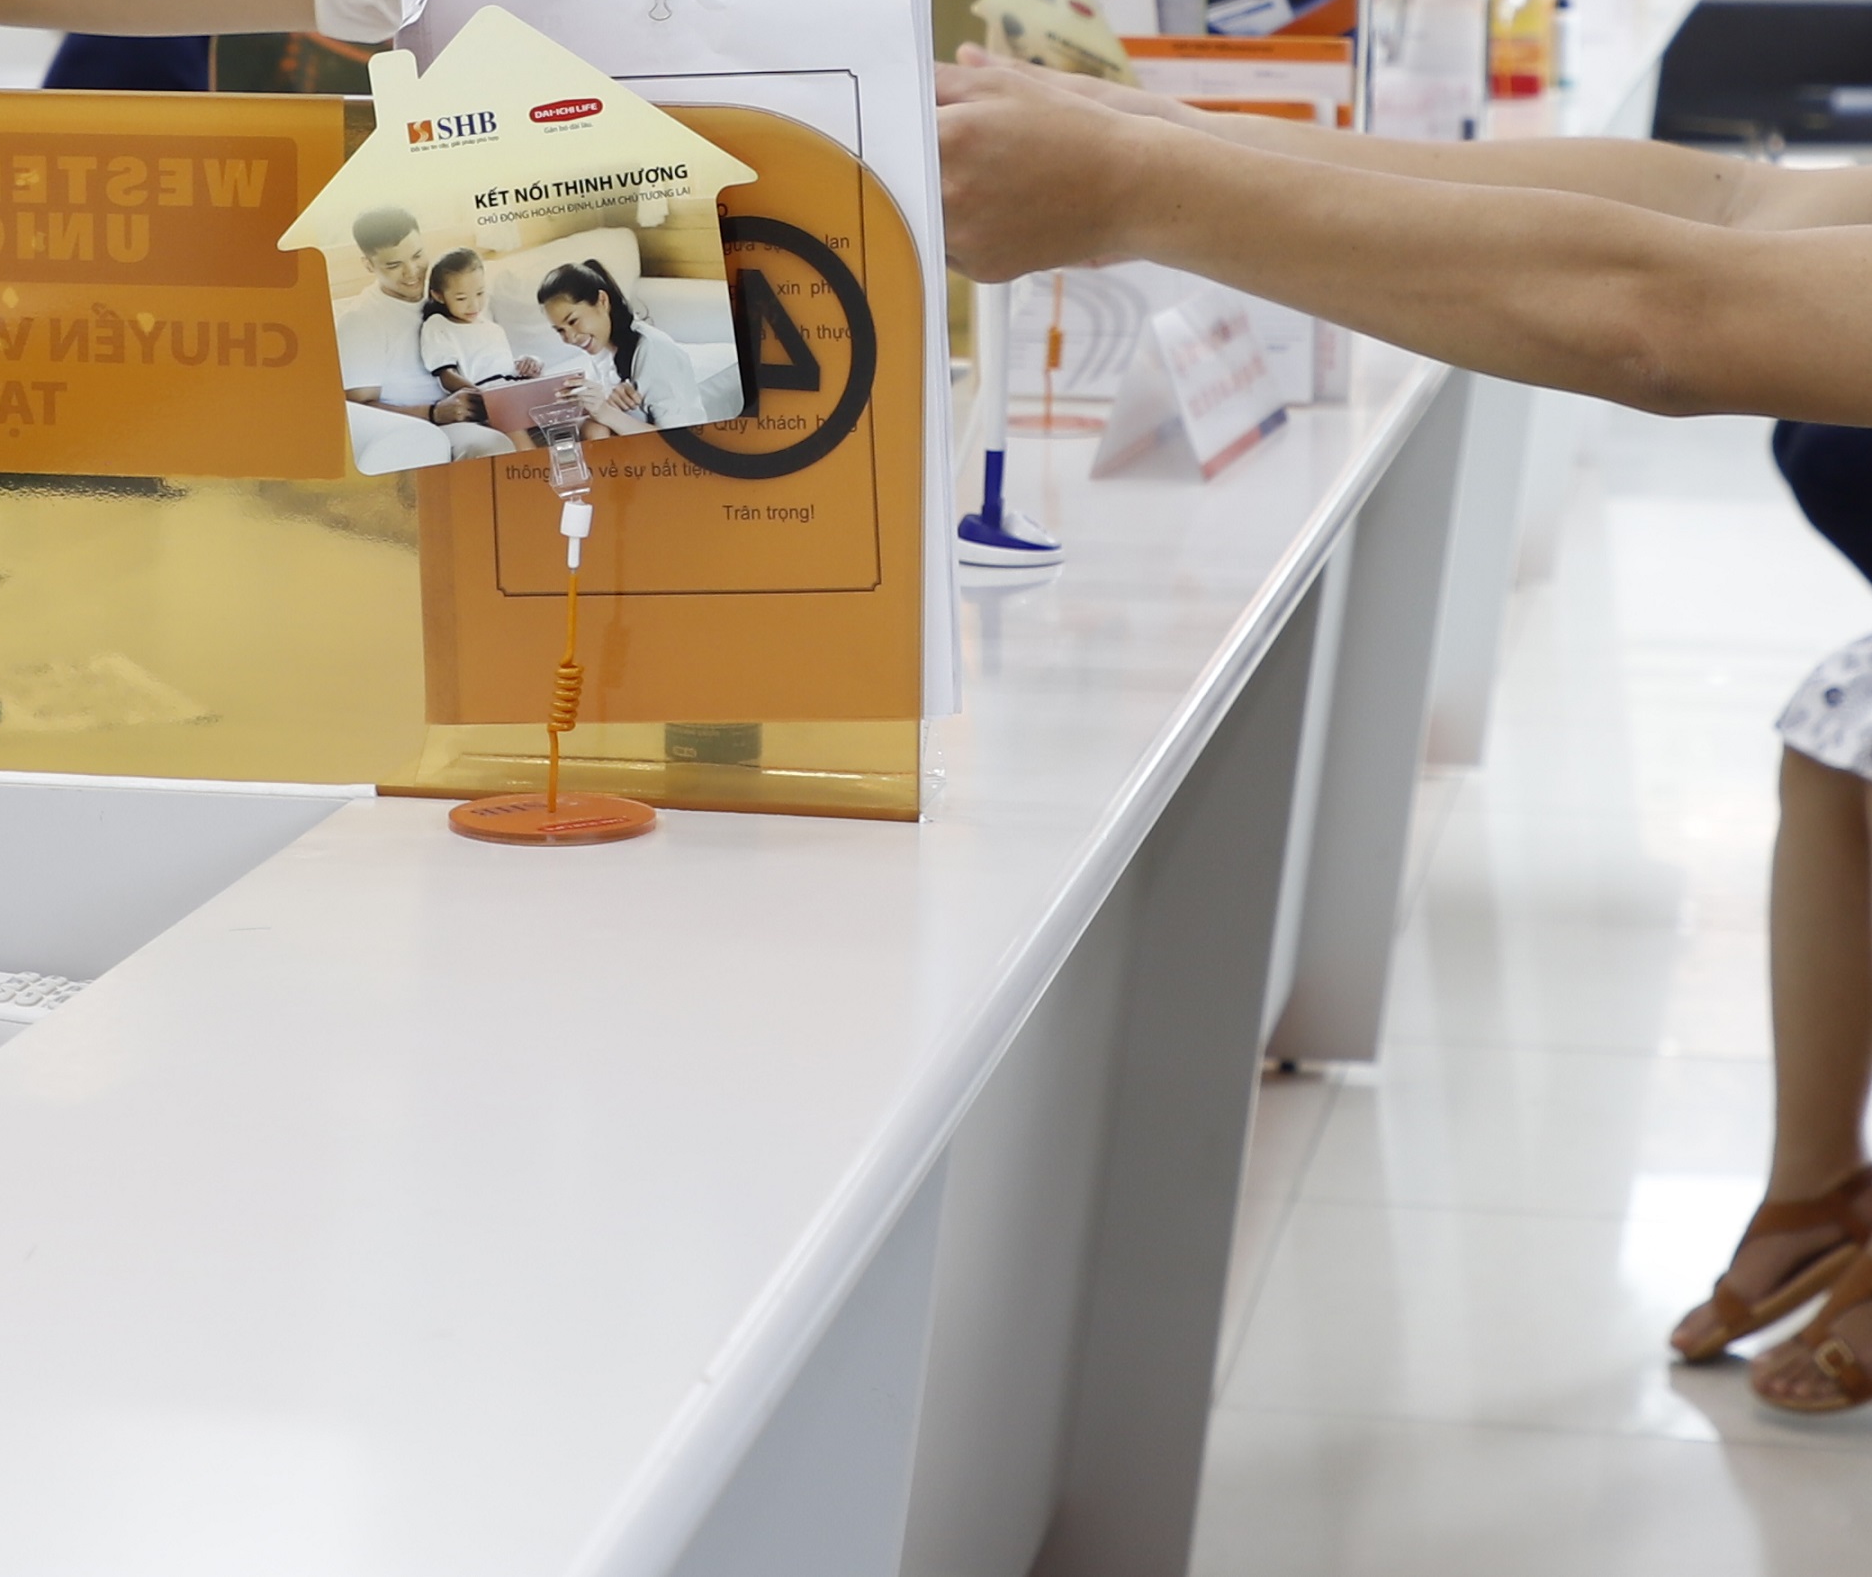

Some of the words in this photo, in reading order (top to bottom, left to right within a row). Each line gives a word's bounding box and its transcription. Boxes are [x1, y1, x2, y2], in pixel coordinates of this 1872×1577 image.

[534, 106, 575, 119] DAI-ICHI
[575, 102, 598, 113] LIFE
[437, 111, 497, 140] SHB
[474, 187, 509, 209] KẾT
[514, 180, 550, 203] NỐI
[552, 175, 613, 198] THỊNH
[616, 164, 688, 188] VƯỢNG
[500, 210, 529, 222] ĐỘNG
[676, 186, 691, 196] LAI
[777, 280, 801, 295] xin
[757, 415, 807, 430] khách
[505, 465, 551, 482] thông
[599, 459, 619, 478] về
[624, 465, 646, 480] sự
[651, 457, 678, 477] bất
[722, 505, 761, 520] Trân
[766, 504, 814, 523] trọng!
